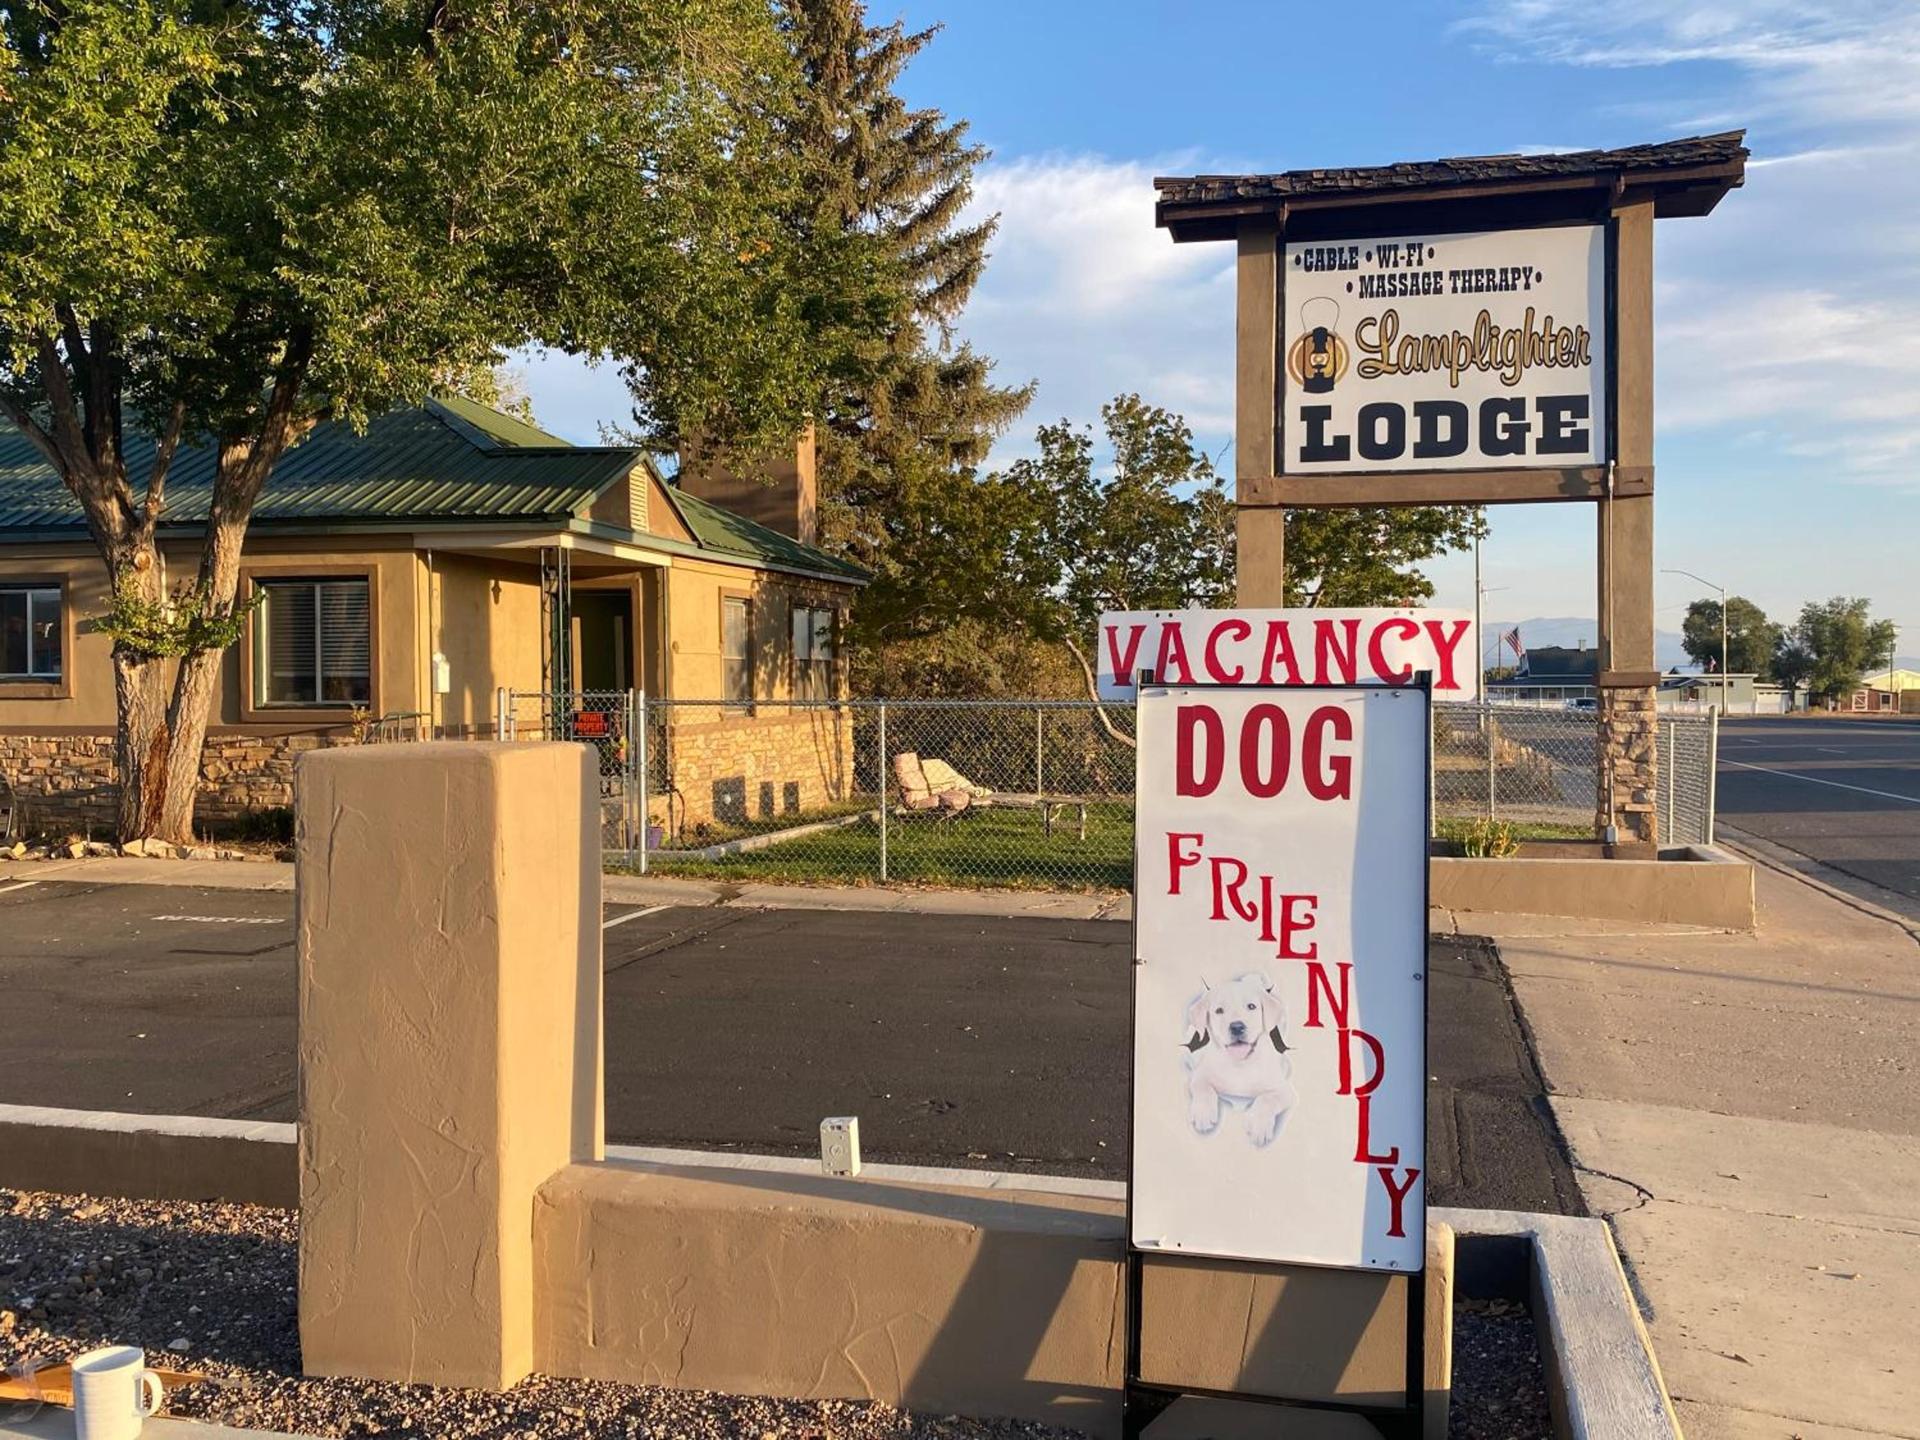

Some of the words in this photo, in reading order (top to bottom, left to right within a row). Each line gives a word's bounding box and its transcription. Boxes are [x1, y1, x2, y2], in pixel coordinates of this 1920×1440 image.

[1304, 246, 1359, 272] CABLE
[1376, 243, 1424, 268] WI-FI
[1359, 271, 1443, 298] MASSAGE
[1449, 266, 1534, 294] THERAPY
[1355, 307, 1591, 388] Lamplighter
[1300, 394, 1590, 463] LODGE
[1104, 618, 1471, 690] VACANCY
[574, 722, 609, 732] PROPERTY
[577, 712, 605, 723] PRIVATE
[1175, 703, 1353, 801] DOG
[1165, 832, 1421, 1237] FRIENDLY
